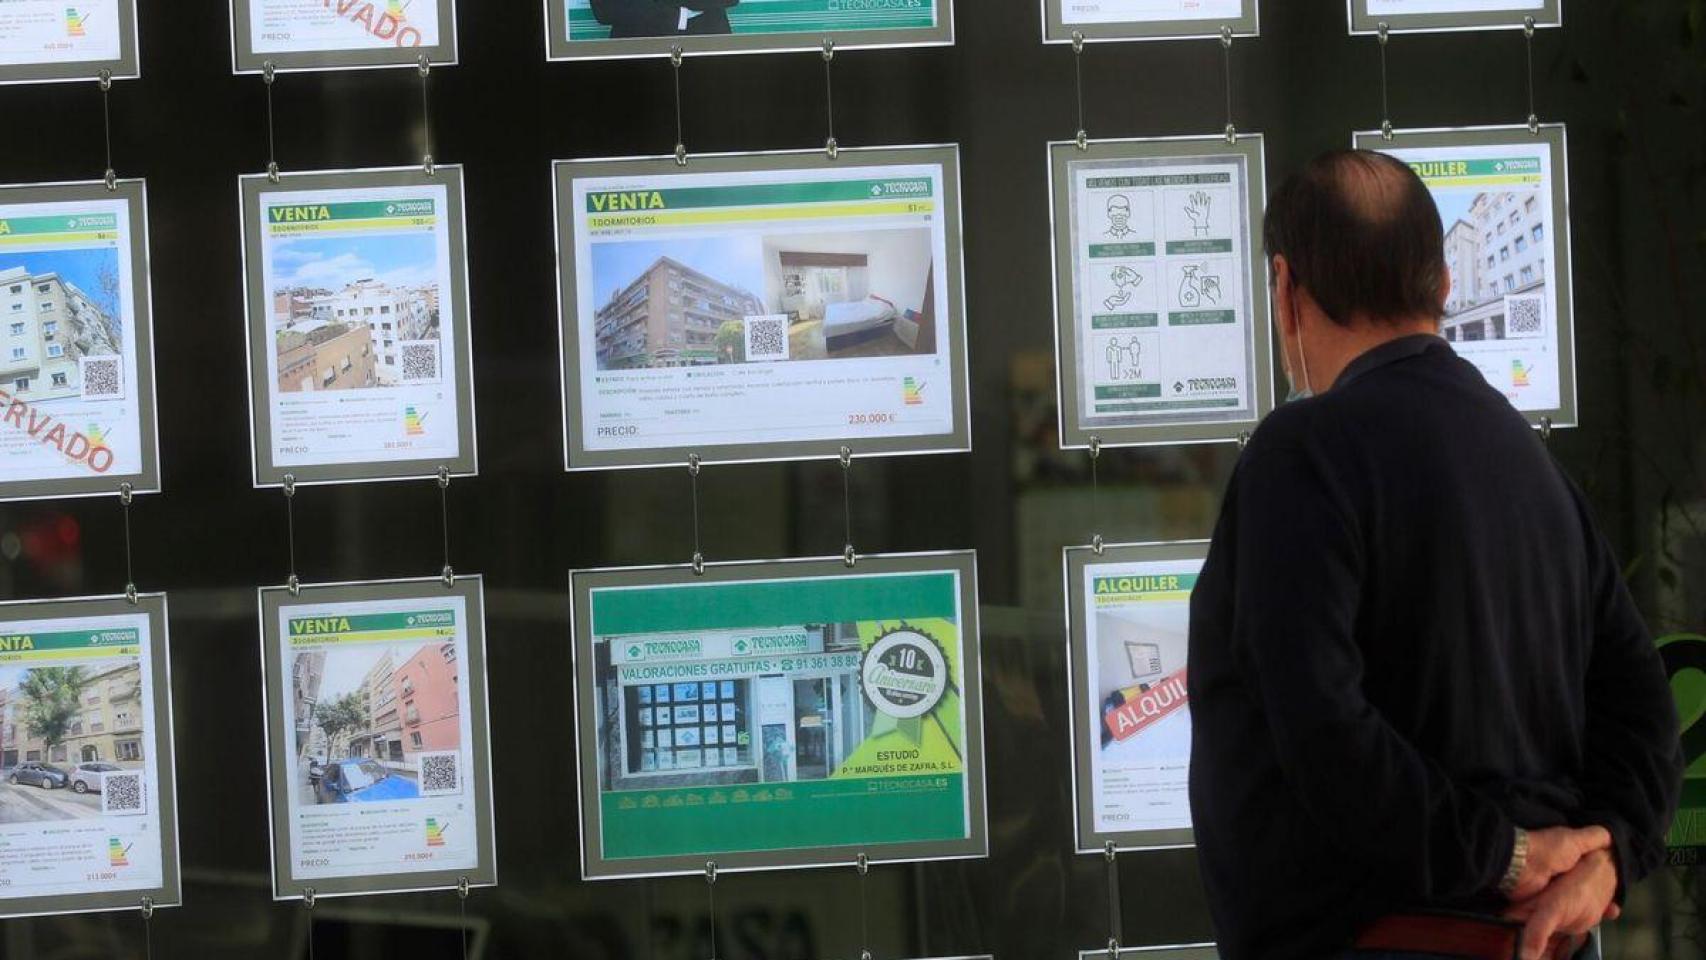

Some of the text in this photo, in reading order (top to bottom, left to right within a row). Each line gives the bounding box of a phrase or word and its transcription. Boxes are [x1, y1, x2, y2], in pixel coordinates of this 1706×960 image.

[592, 191, 665, 211] VENTA
[272, 206, 330, 221] VENTA
[1097, 575, 1179, 593] ALQUILER
[292, 618, 350, 634] VENTA
[752, 633, 807, 648] TECNOCASA
[899, 647, 916, 669] 10
[622, 660, 770, 680] VALORACIONES GRATUITAS
[876, 749, 920, 761] ESTUDIO
[896, 763, 908, 772] DE
